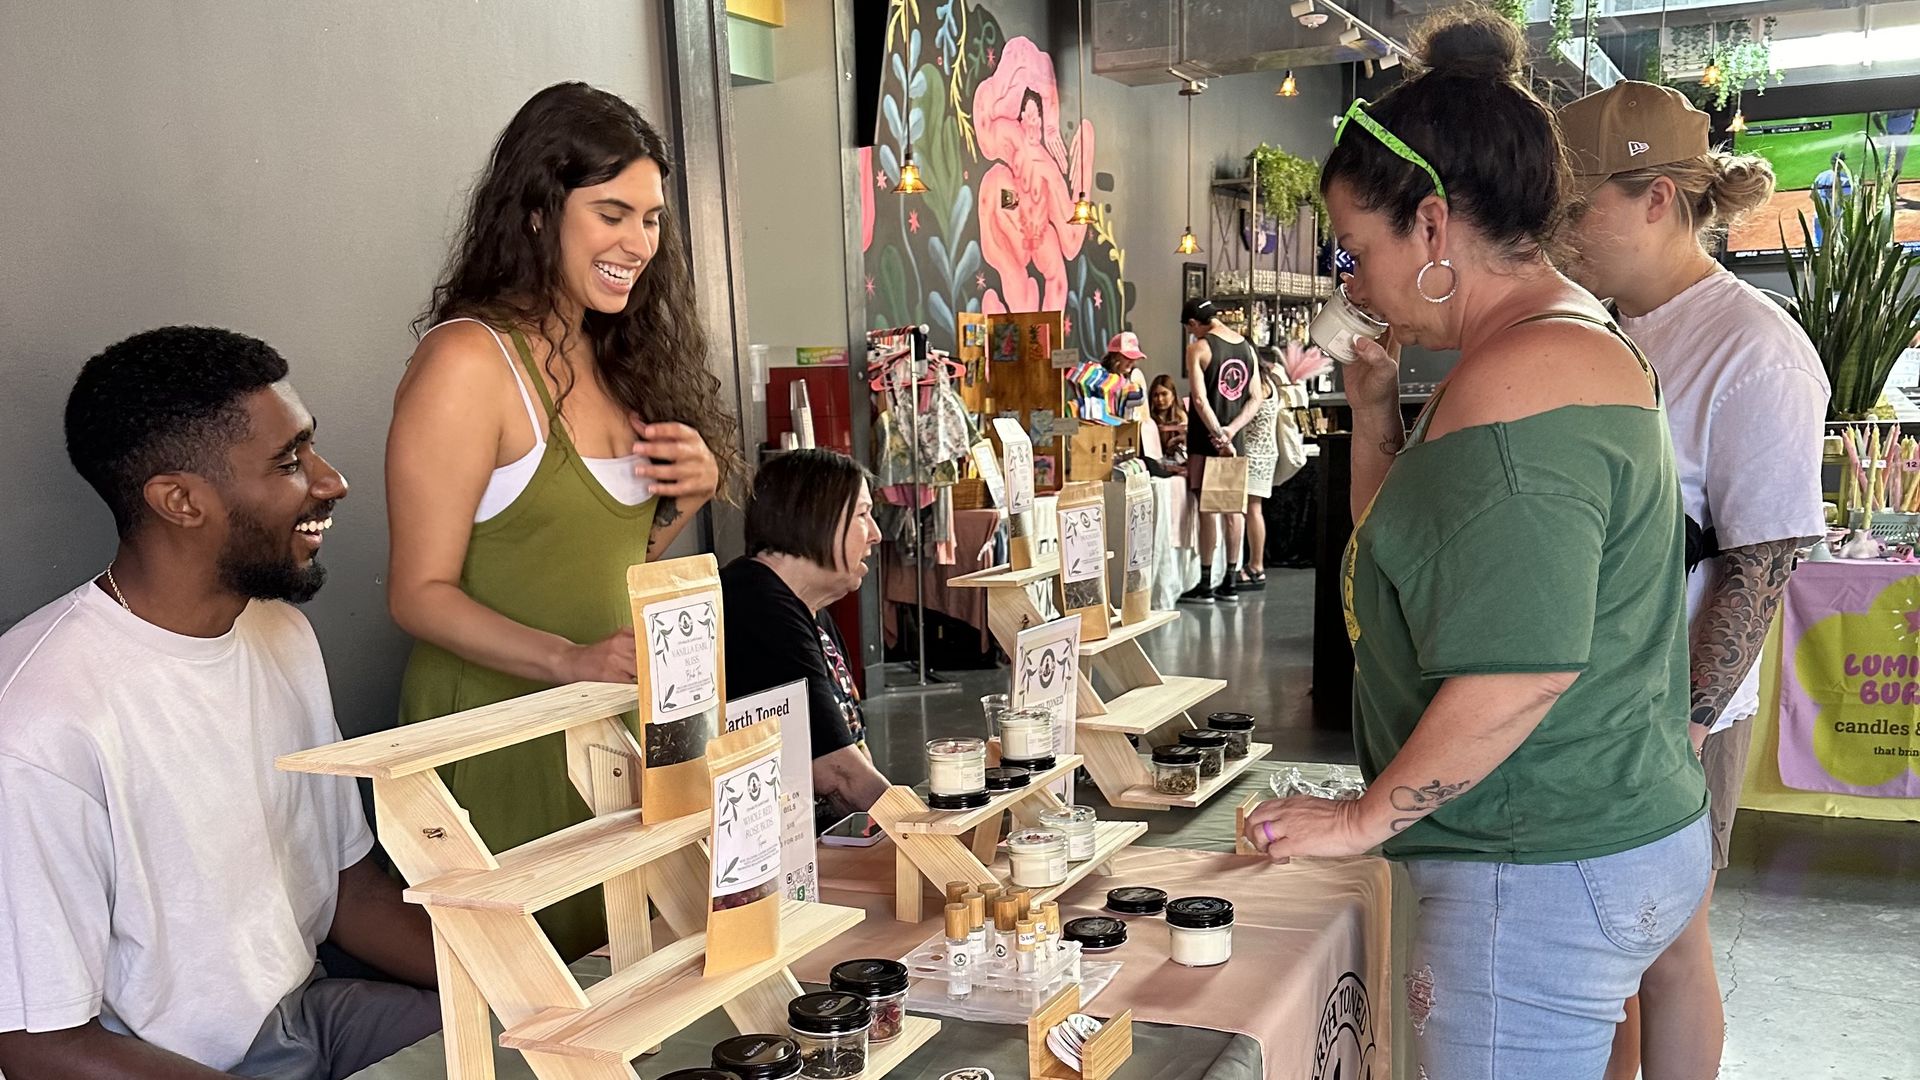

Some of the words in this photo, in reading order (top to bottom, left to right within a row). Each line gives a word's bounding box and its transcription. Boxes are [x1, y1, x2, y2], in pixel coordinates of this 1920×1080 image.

[1844, 653, 1919, 678] LUMI
[725, 709, 753, 734] arth
[755, 697, 790, 722] Toned
[1834, 719, 1910, 736] candles
[1874, 746, 1896, 756] that
